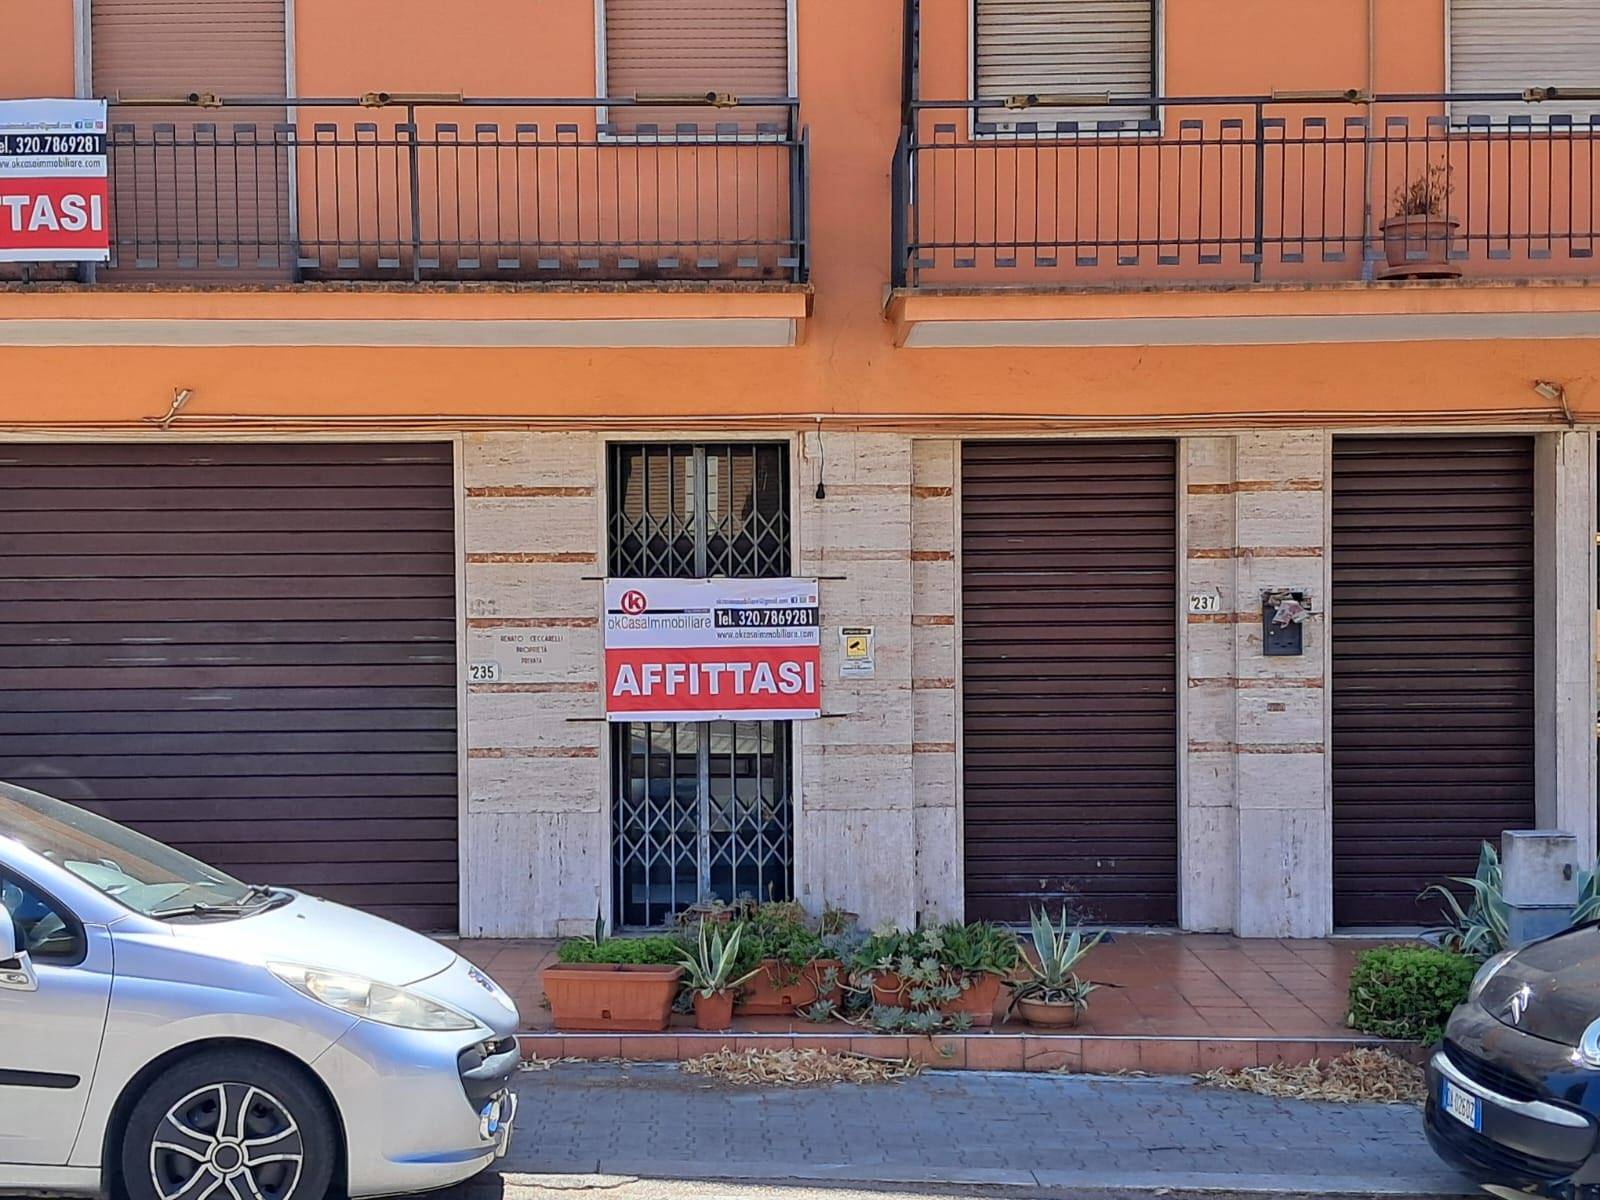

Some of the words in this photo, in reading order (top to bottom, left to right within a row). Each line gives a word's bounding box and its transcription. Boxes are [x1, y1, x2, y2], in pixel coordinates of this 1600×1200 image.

[16, 136, 100, 153] 320.7869281
[0, 194, 102, 231] TASI
[1193, 596, 1215, 610] 237
[716, 609, 735, 626] Tel.
[738, 608, 813, 626] 320.7869281
[472, 665, 494, 679] 235
[612, 661, 815, 697] AFFITTASI
